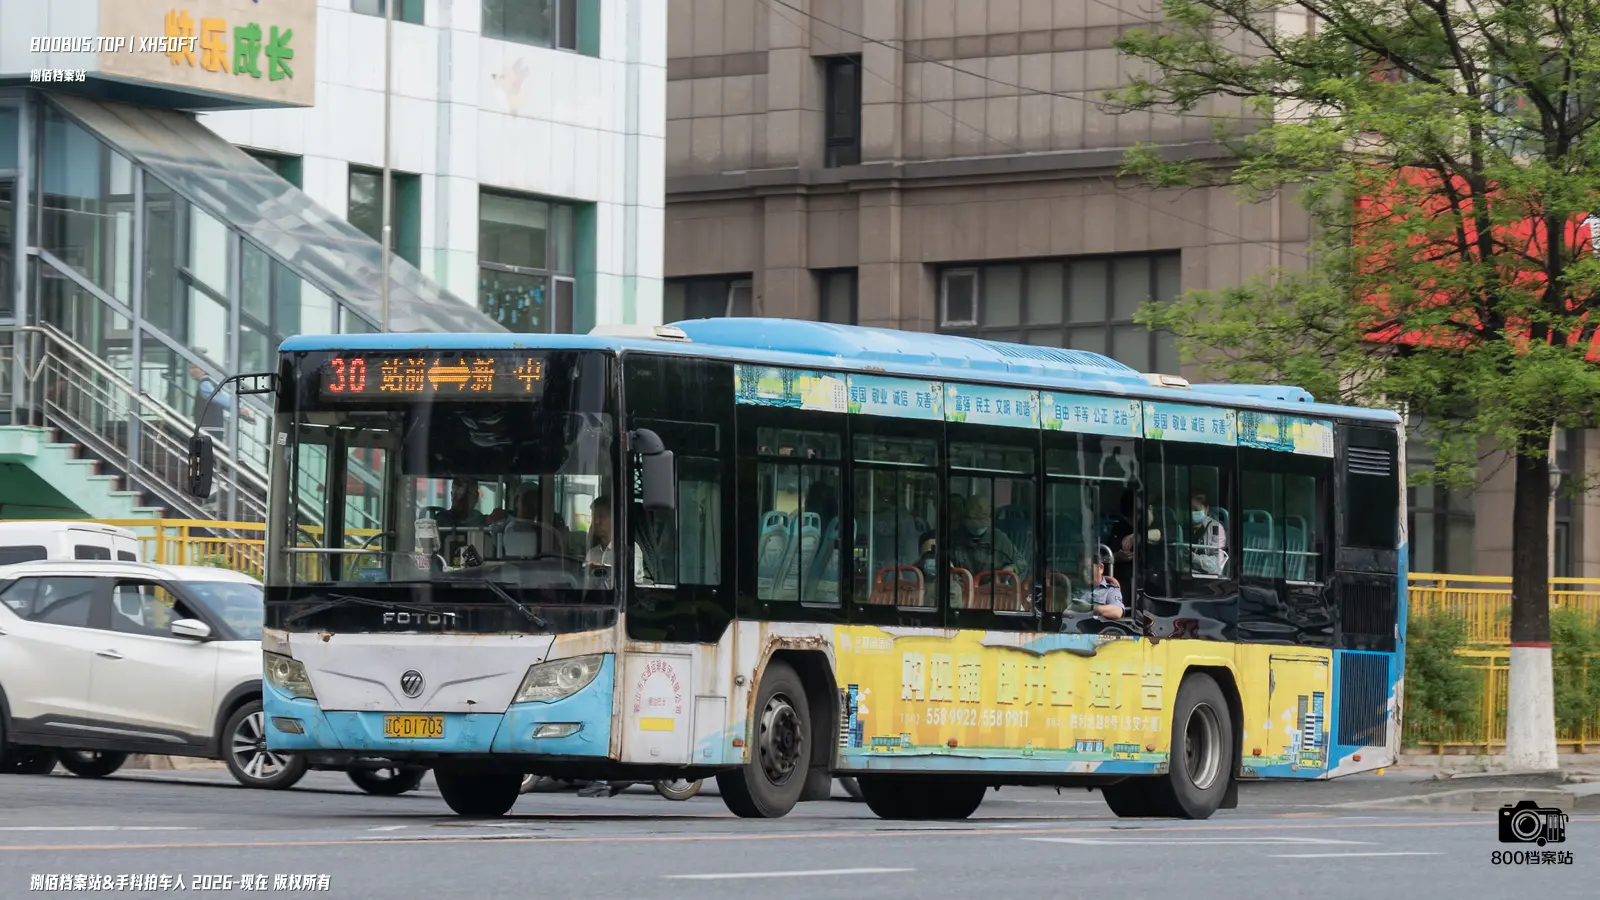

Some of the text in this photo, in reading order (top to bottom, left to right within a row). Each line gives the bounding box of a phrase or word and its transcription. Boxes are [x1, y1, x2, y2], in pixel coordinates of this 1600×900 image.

[164, 8, 295, 81] 快乐成长
[329, 358, 366, 393] 30
[380, 358, 425, 392] 站前
[850, 386, 867, 403] 爱国
[872, 387, 888, 405] 敬业
[892, 389, 909, 407] 诚信
[915, 391, 932, 409] 友善
[955, 395, 1031, 417] 富强 民主 文明 和谐
[1055, 404, 1128, 426] 自由 平等 公正 法治
[1153, 412, 1226, 435] 爱国 敬业 诚信 友善
[383, 612, 456, 625] FOTON
